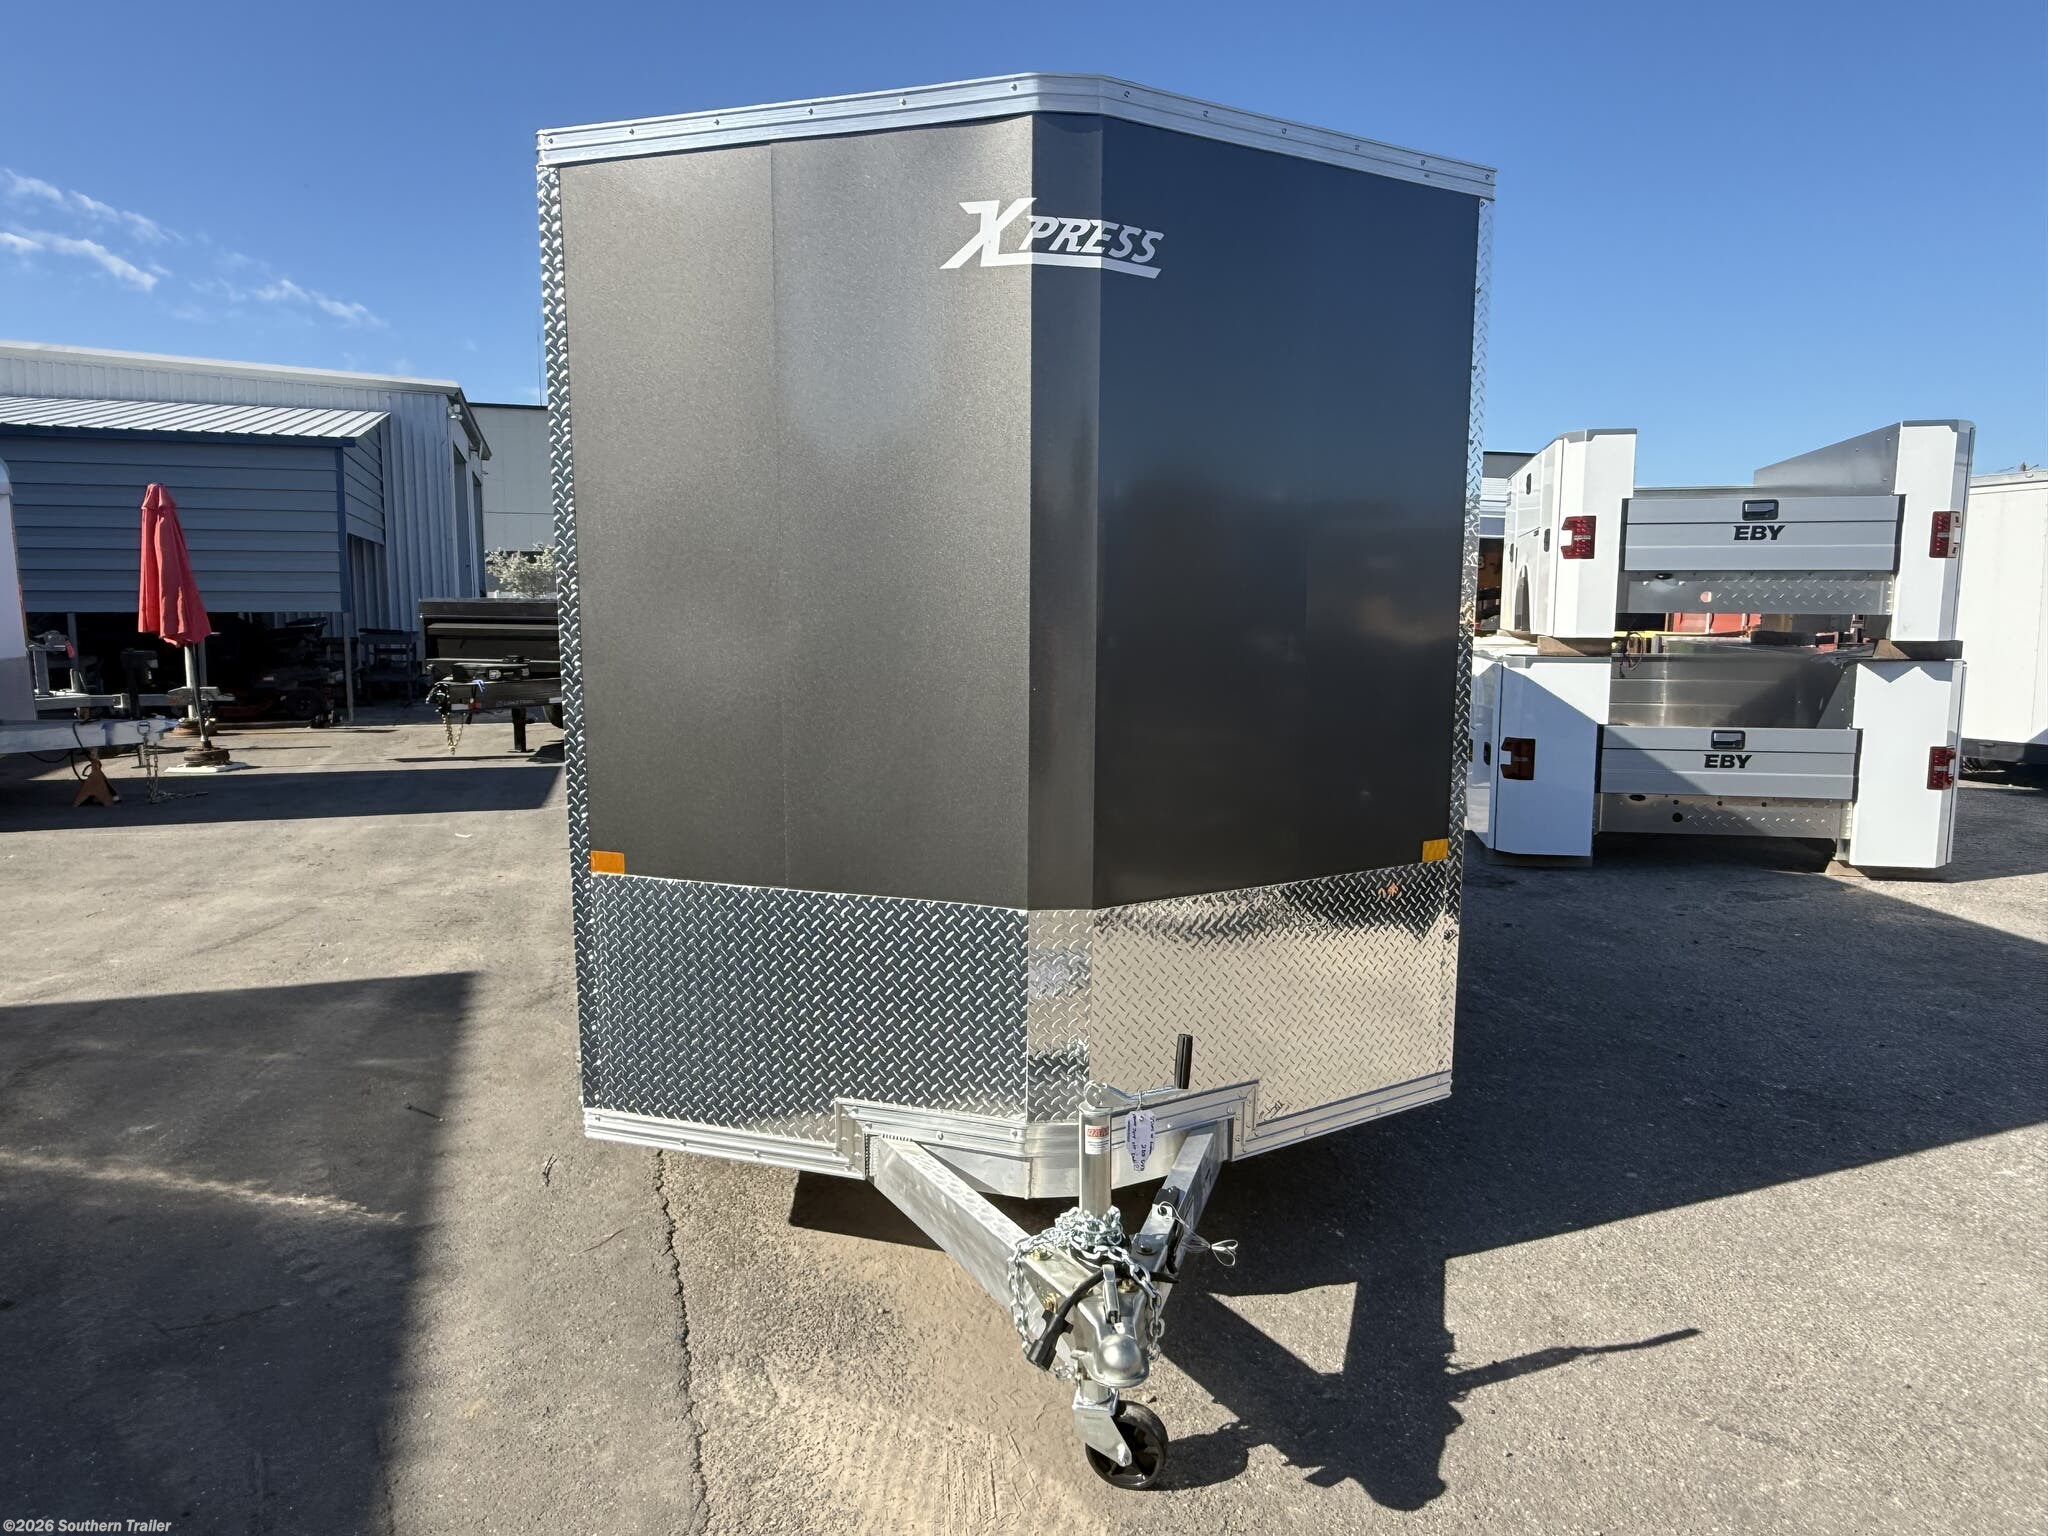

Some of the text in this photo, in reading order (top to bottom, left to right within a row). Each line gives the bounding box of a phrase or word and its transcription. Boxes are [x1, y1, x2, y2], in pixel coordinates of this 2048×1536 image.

[940, 197, 1165, 279] XPRESS
[1733, 525, 1786, 541] EBY
[1704, 754, 1752, 769] EBY
